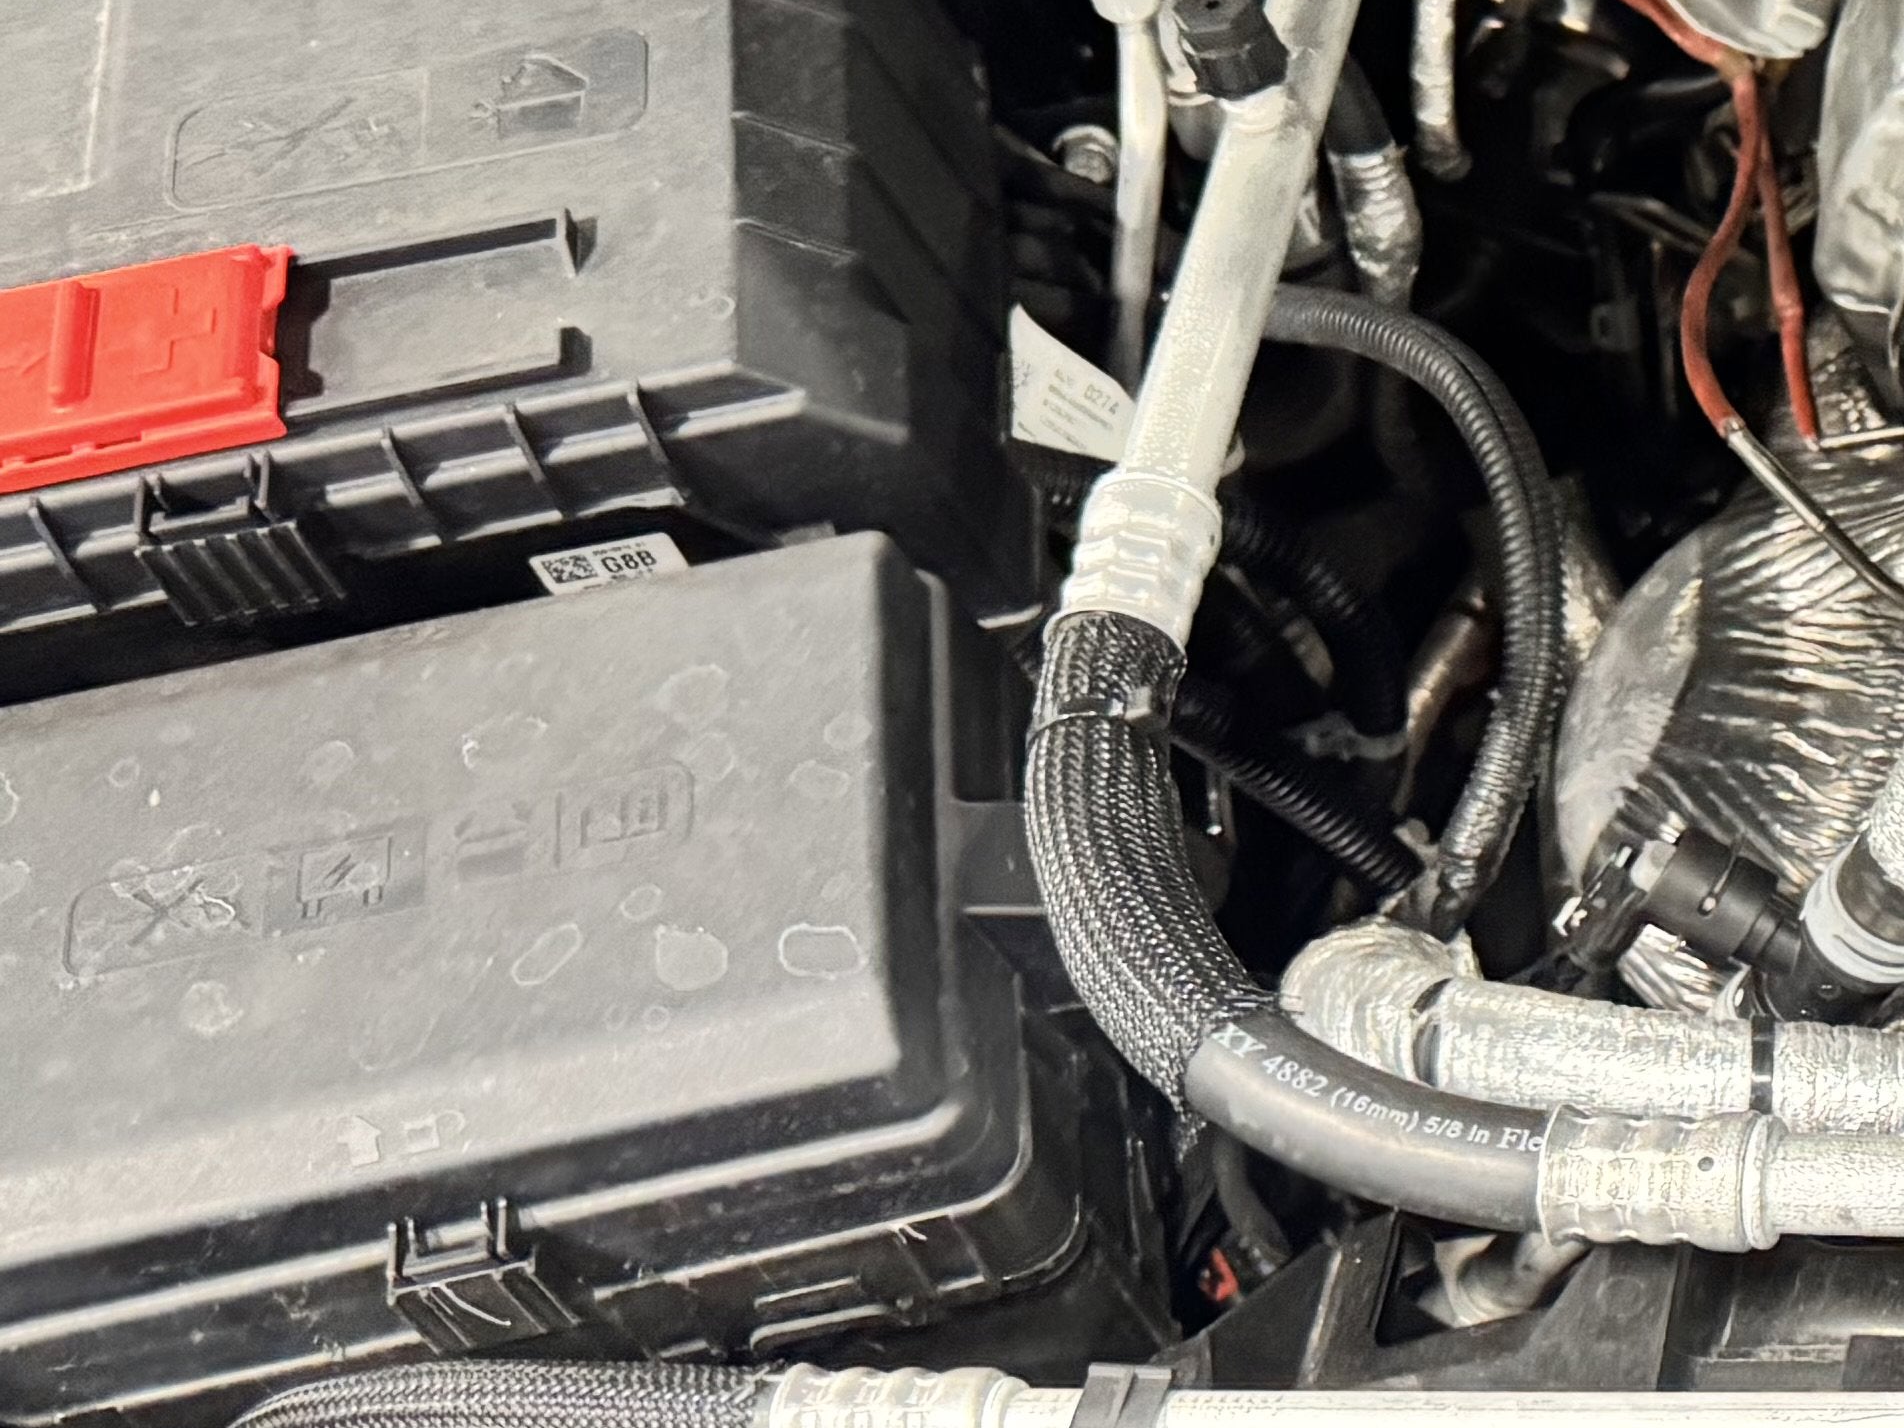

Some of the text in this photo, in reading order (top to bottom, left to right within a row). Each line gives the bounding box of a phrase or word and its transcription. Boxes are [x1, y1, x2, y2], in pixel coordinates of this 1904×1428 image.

[601, 550, 657, 574] G8B
[1262, 1054, 1329, 1098] 4882
[1330, 1085, 1420, 1133] (16mm)
[1422, 1115, 1465, 1139] 5/8
